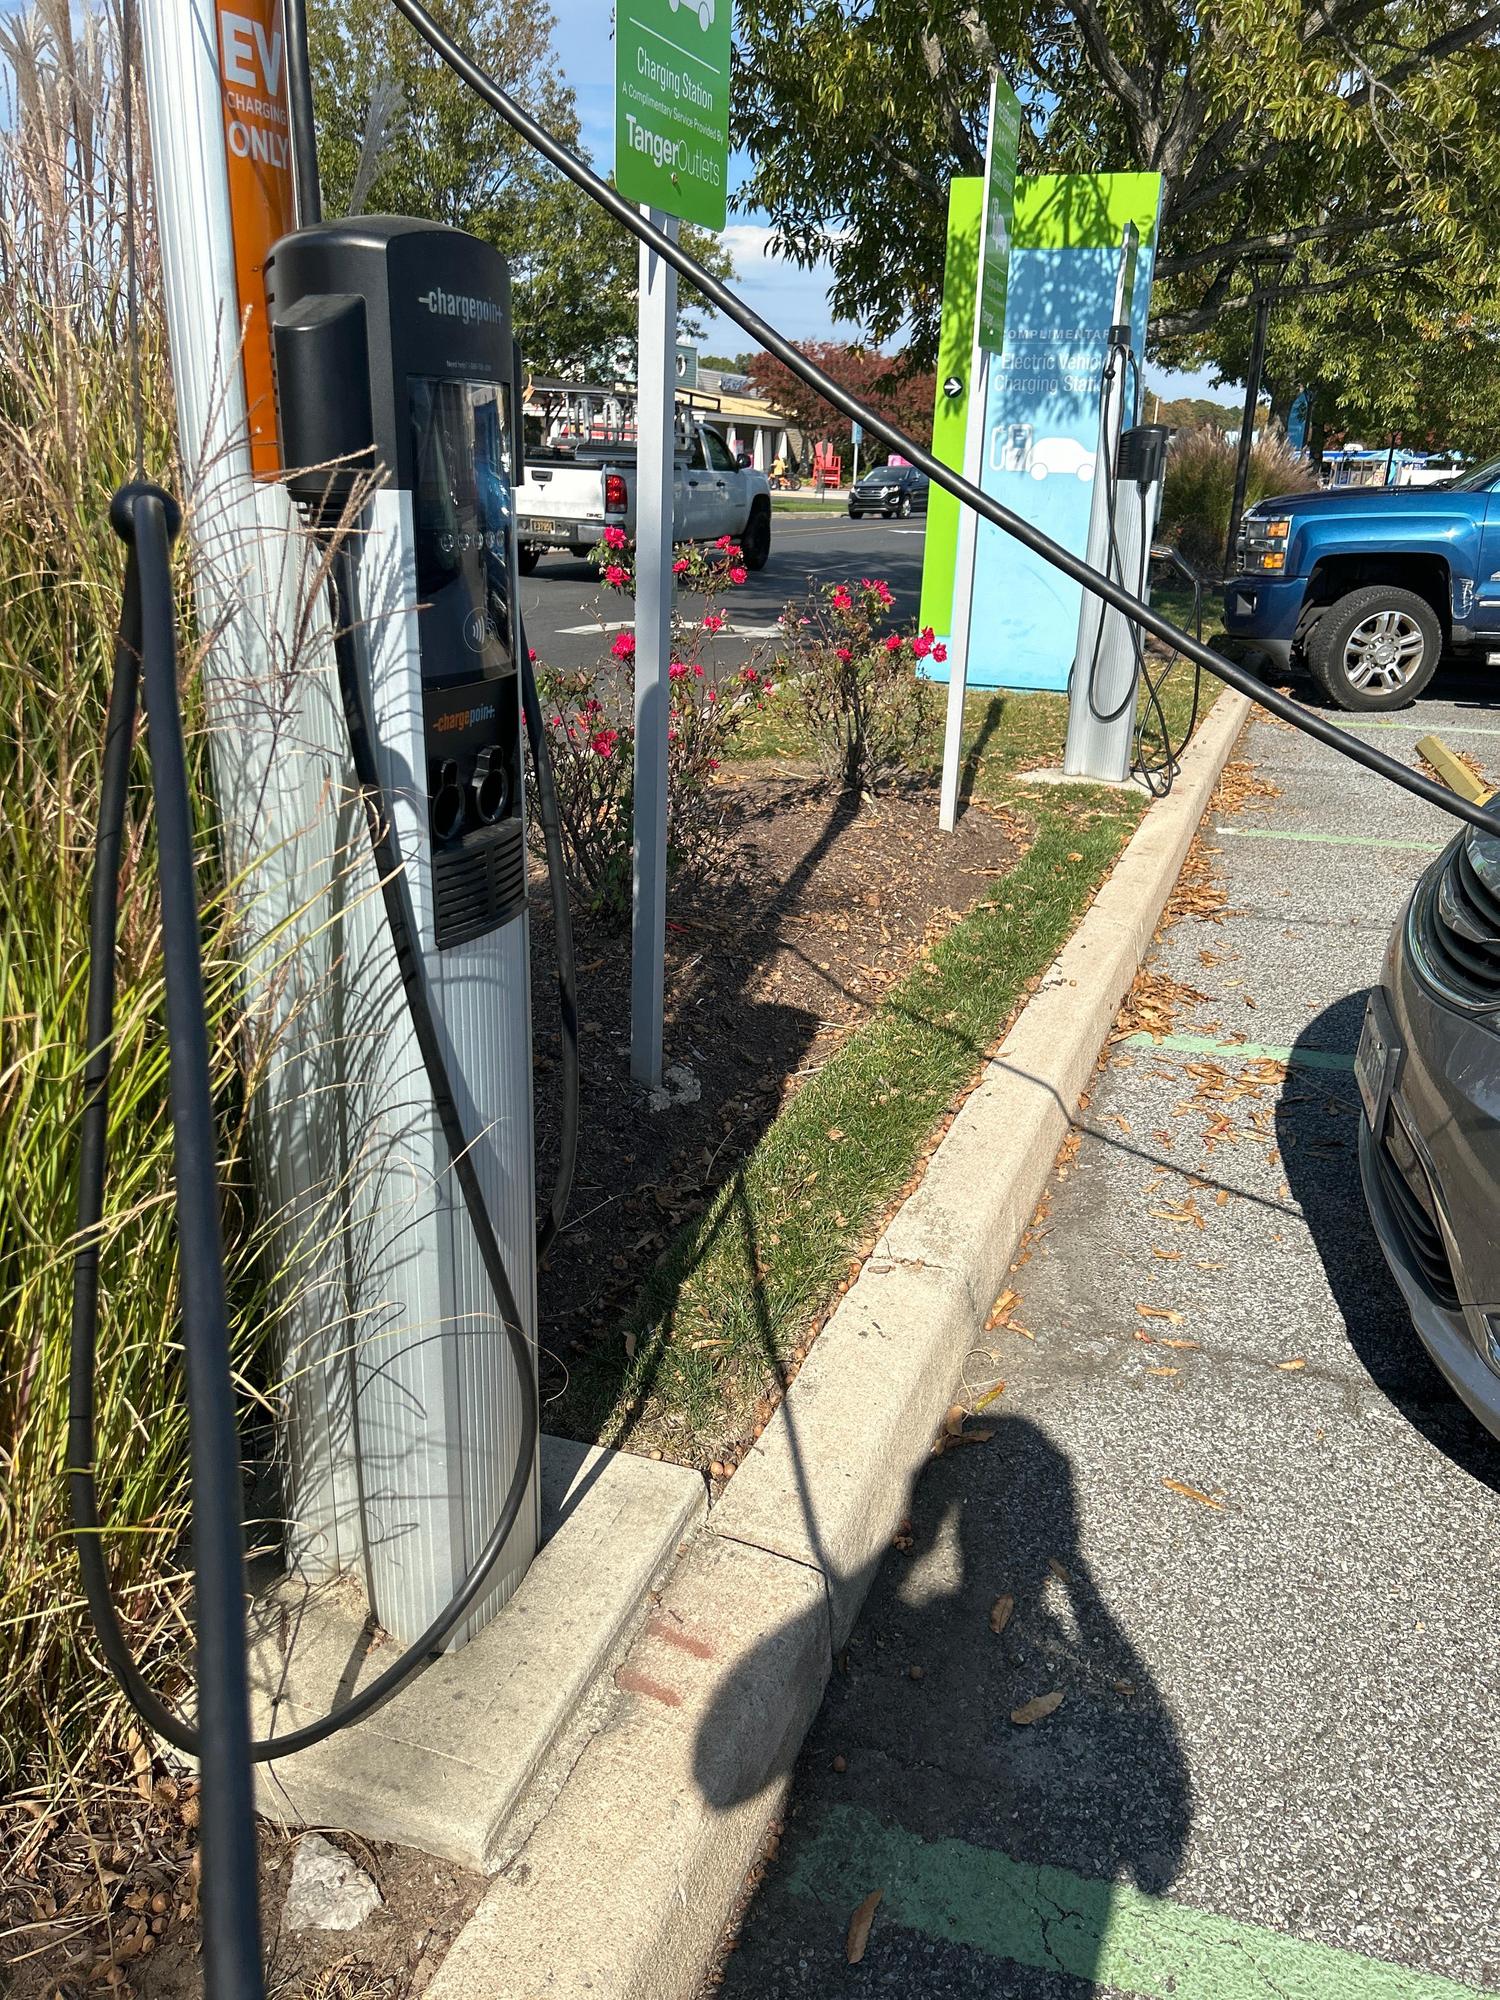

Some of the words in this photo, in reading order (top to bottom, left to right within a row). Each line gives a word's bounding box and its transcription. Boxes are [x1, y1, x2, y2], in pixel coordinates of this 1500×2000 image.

[221, 10, 281, 96] EV
[637, 46, 680, 100] Charging
[682, 72, 713, 112] Station
[226, 91, 286, 125] CHARGING
[622, 81, 628, 95] A
[628, 84, 672, 121] Complimentary
[673, 107, 693, 128] Service
[693, 118, 717, 138] Provided
[716, 130, 724, 145] By
[228, 120, 289, 170] ONLY
[994, 374, 1058, 395] Charging
[1001, 352, 1055, 370] Electric
